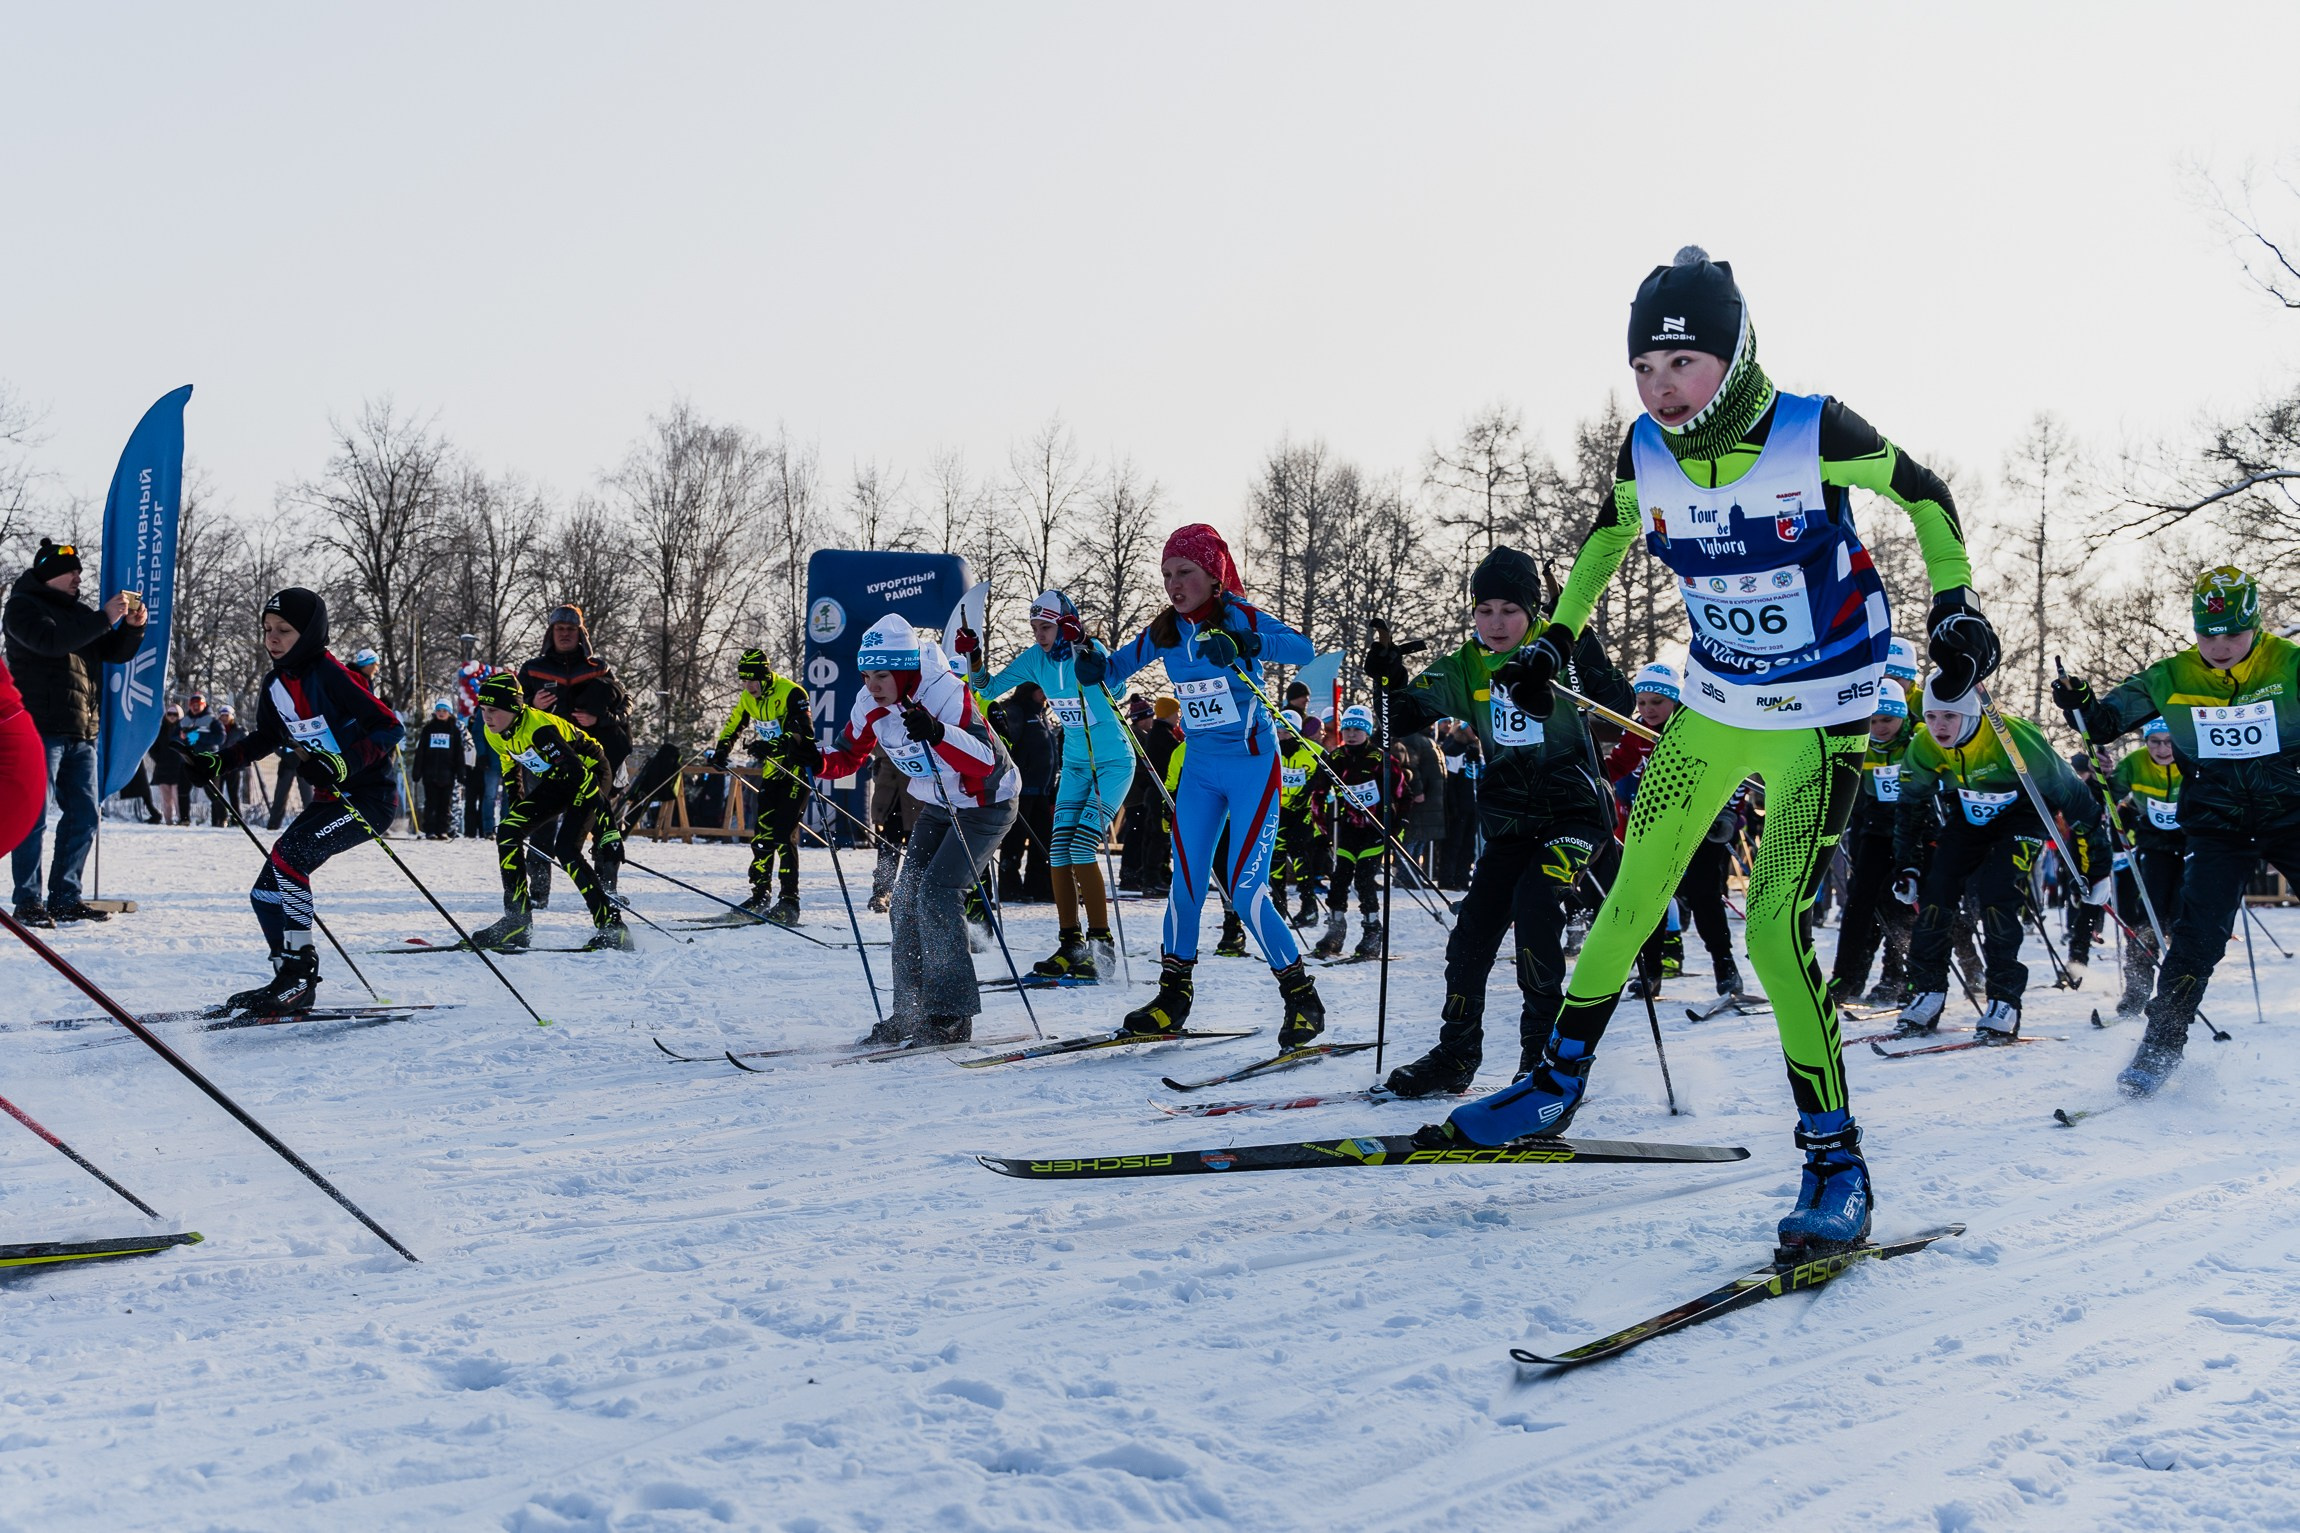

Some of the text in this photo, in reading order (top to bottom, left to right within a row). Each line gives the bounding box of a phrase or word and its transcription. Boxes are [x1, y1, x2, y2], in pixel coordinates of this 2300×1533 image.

[1688, 505, 1718, 523] Tour
[136, 468, 152, 600] ОРТИВНЫЙ
[1717, 523, 1729, 535] de
[1697, 538, 1747, 559] Vyborg
[147, 501, 164, 624] ПЕТЕРБУРГ
[866, 570, 936, 594] КУРОРТНЫЙ
[885, 585, 923, 601] РАЙОН
[1703, 604, 1788, 636] 606
[857, 655, 887, 666] 025
[1886, 668, 1903, 676] 25
[1636, 685, 1671, 696] 2025
[1187, 698, 1223, 718] 614
[1756, 696, 1782, 706] RUN
[1778, 702, 1803, 711] LAB
[1878, 703, 1891, 712] 25
[1060, 710, 1083, 722] 617
[1494, 707, 1527, 732] 618
[1342, 720, 1366, 728] 2025
[2145, 722, 2168, 730] 025
[2209, 726, 2262, 747] 630
[1543, 836, 1594, 851] SESTRORETSK
[277, 980, 308, 1002] SPINE
[1806, 1140, 1842, 1150] SPINE
[1030, 1153, 1173, 1172] FISCHER
[1402, 1150, 1576, 1165] FISCHER
[1842, 1175, 1865, 1220] SPINE
